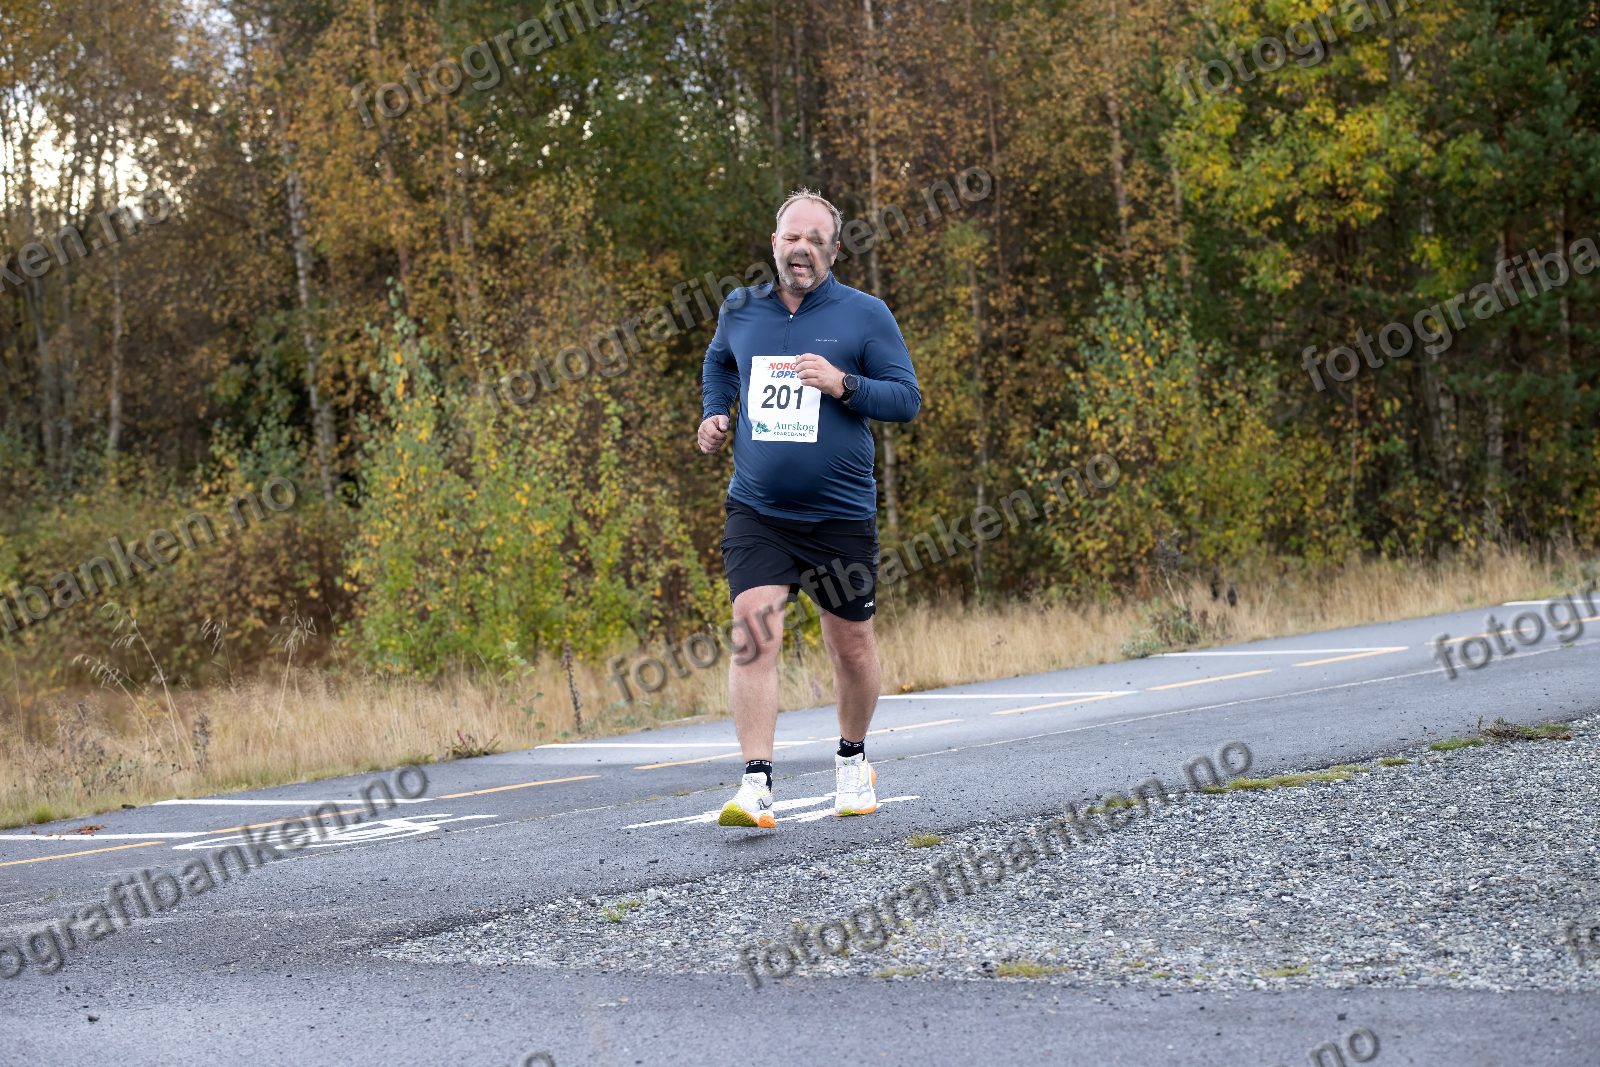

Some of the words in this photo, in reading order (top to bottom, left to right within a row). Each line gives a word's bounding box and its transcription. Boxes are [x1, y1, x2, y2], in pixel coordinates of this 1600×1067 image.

[769, 362, 798, 370] NORG
[761, 384, 803, 409] 201
[773, 421, 815, 435] Aurskog
